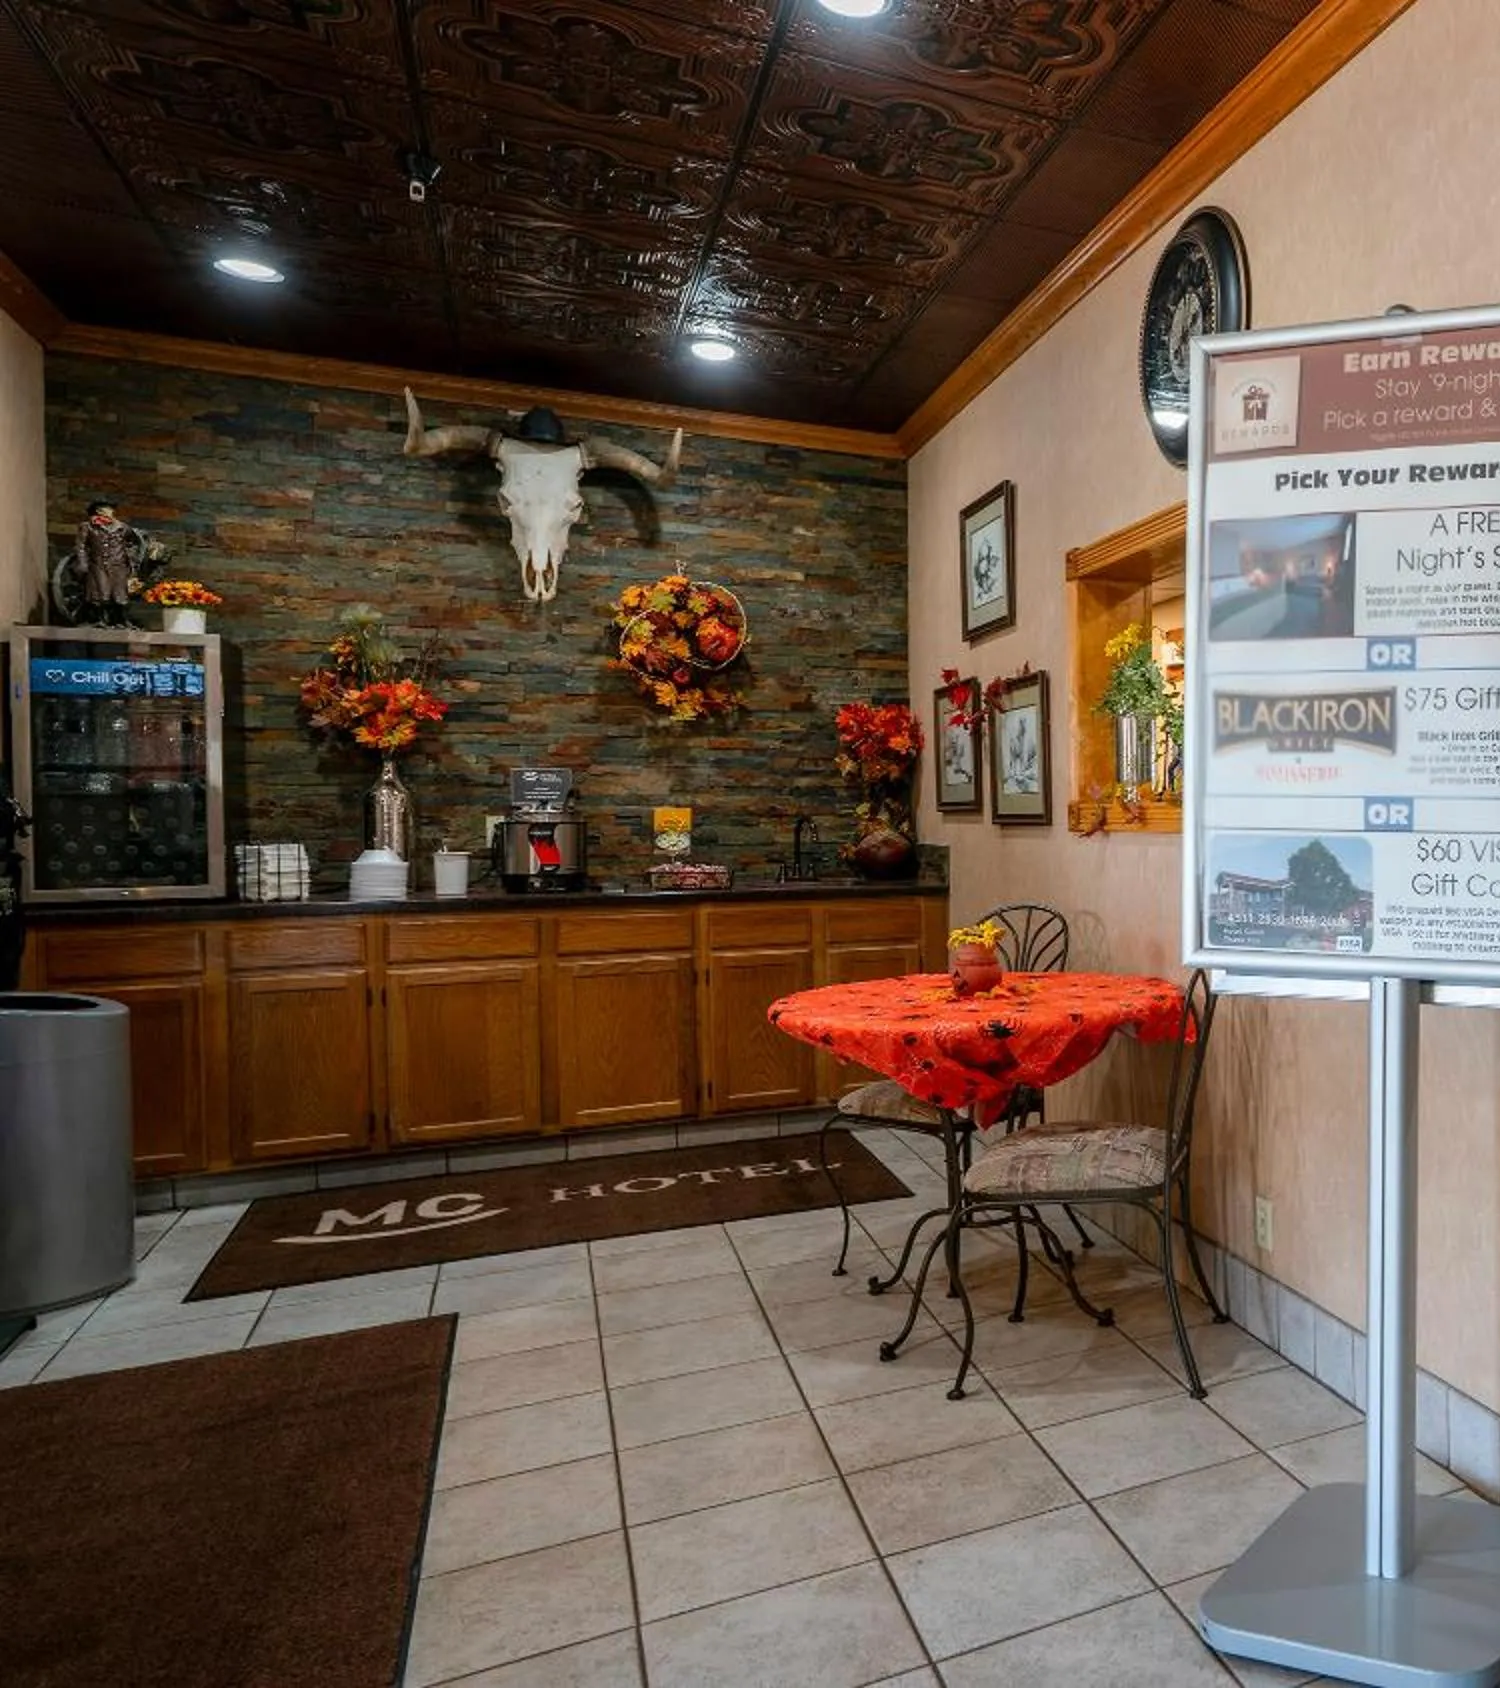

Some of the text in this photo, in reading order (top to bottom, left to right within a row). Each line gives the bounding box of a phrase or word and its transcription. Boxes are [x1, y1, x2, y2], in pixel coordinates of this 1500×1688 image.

[1343, 346, 1411, 374] Earn
[1375, 377, 1421, 400] Stay
[1323, 407, 1367, 432] Pick
[1372, 410, 1388, 427] a
[1393, 400, 1473, 424] reward
[1480, 397, 1497, 418] &
[1275, 469, 1329, 492] Pick
[1338, 466, 1400, 489] Your
[1429, 513, 1449, 536] A
[1396, 545, 1486, 577] Night's
[1369, 643, 1413, 665] OR
[71, 671, 145, 685] Chill Out
[1403, 687, 1447, 712] $75
[1367, 803, 1410, 826] OR
[1416, 836, 1462, 863] $60
[1411, 872, 1459, 897] Gift
[313, 1158, 842, 1235] MC HOTEL
